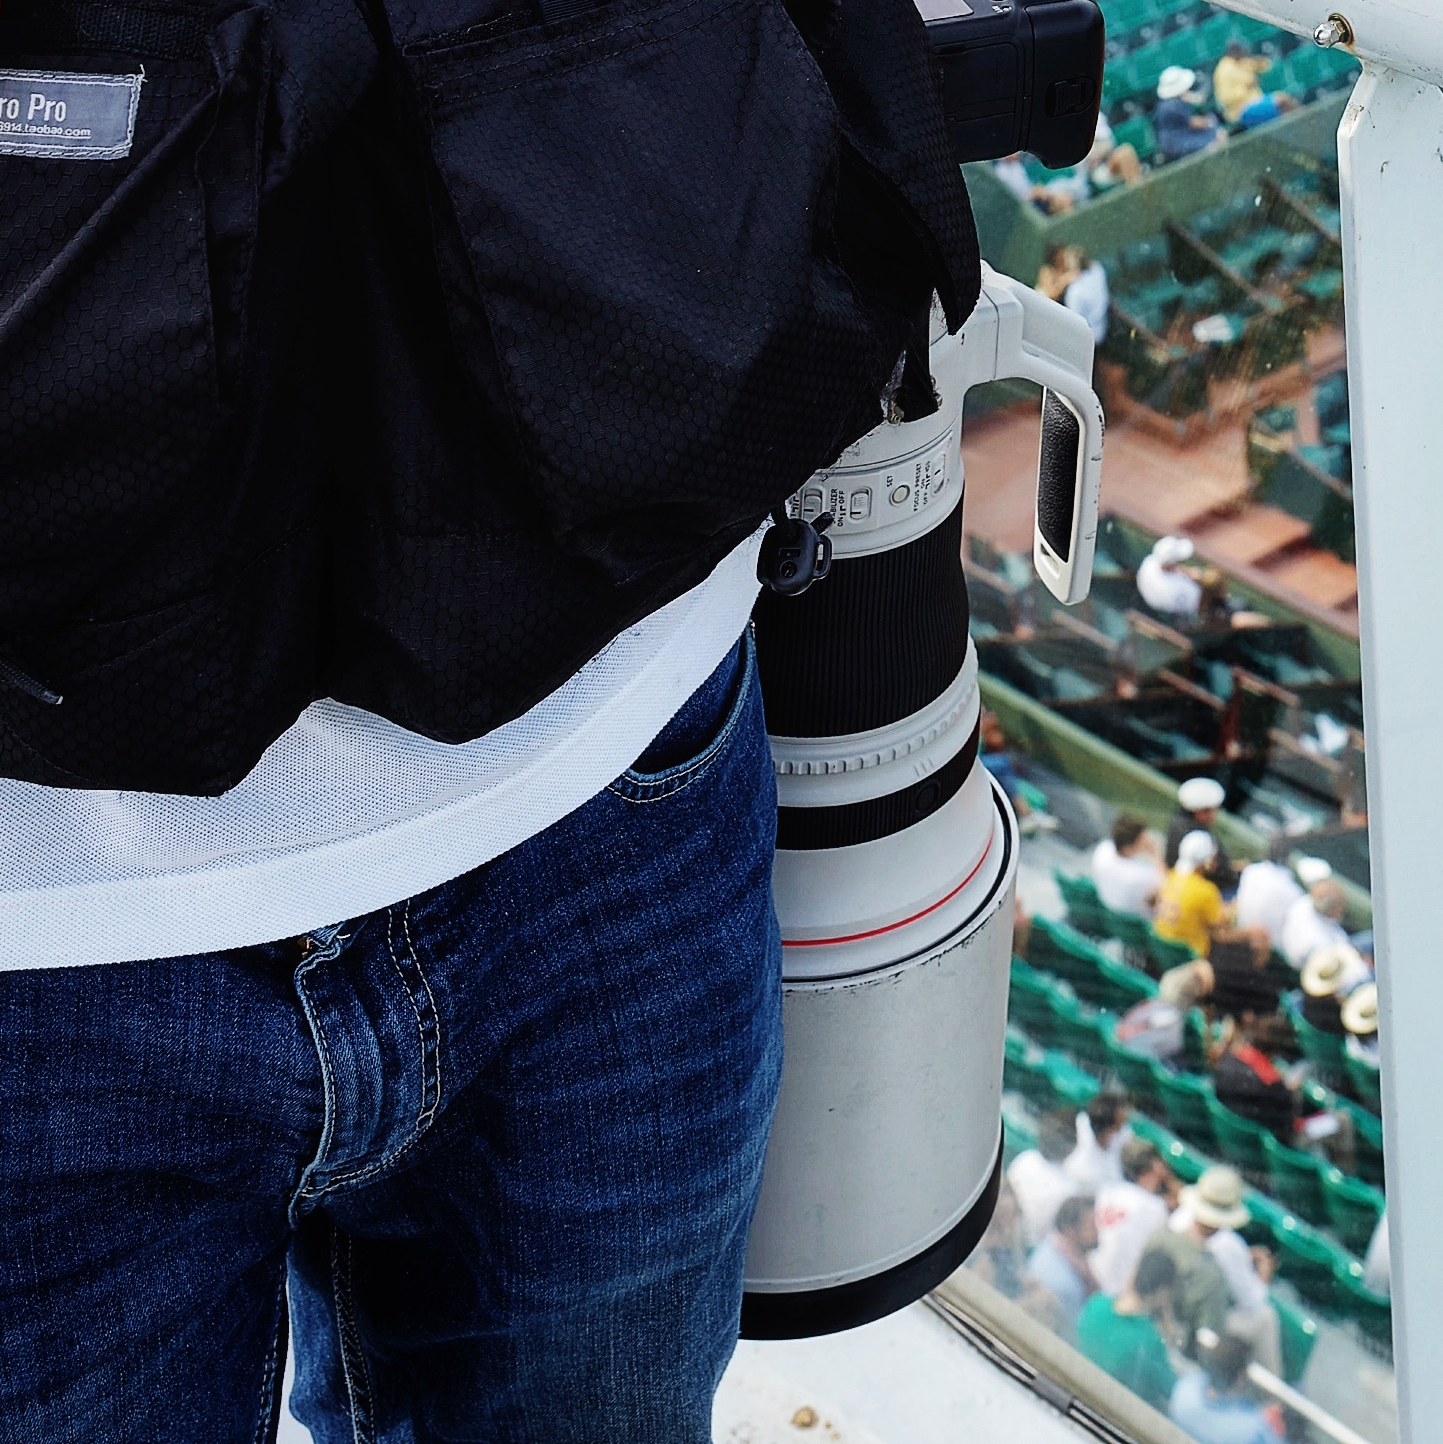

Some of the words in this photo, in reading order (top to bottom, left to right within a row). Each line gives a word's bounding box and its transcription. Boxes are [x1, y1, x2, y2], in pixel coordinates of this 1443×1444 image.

[27, 93, 68, 123] Pro
[829, 488, 838, 524] ABILIZER
[837, 516, 844, 527] ON
